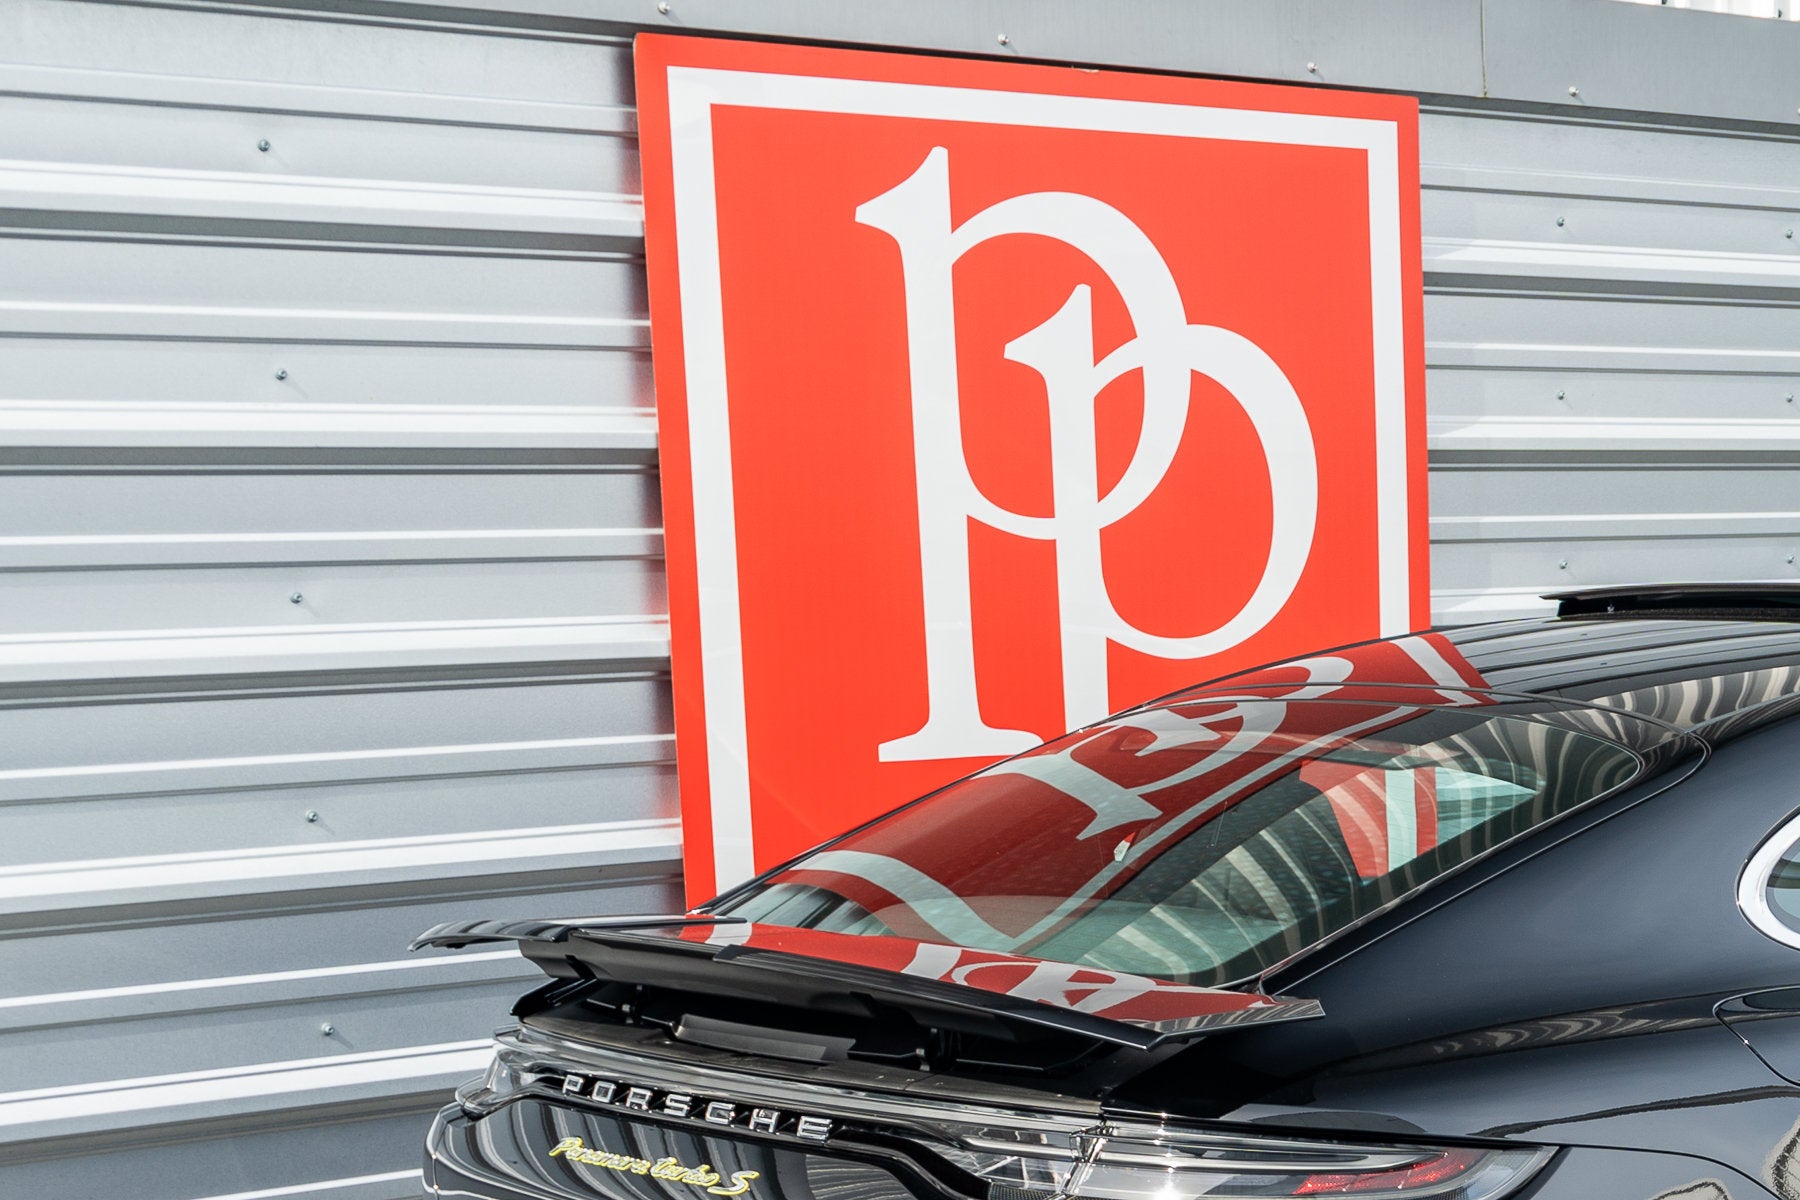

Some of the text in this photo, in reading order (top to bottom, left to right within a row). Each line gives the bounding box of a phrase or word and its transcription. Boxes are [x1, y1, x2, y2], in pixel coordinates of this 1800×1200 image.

[562, 1074, 833, 1141] PORSCHE
[549, 1136, 652, 1175] Panamera
[707, 1170, 760, 1196] S
